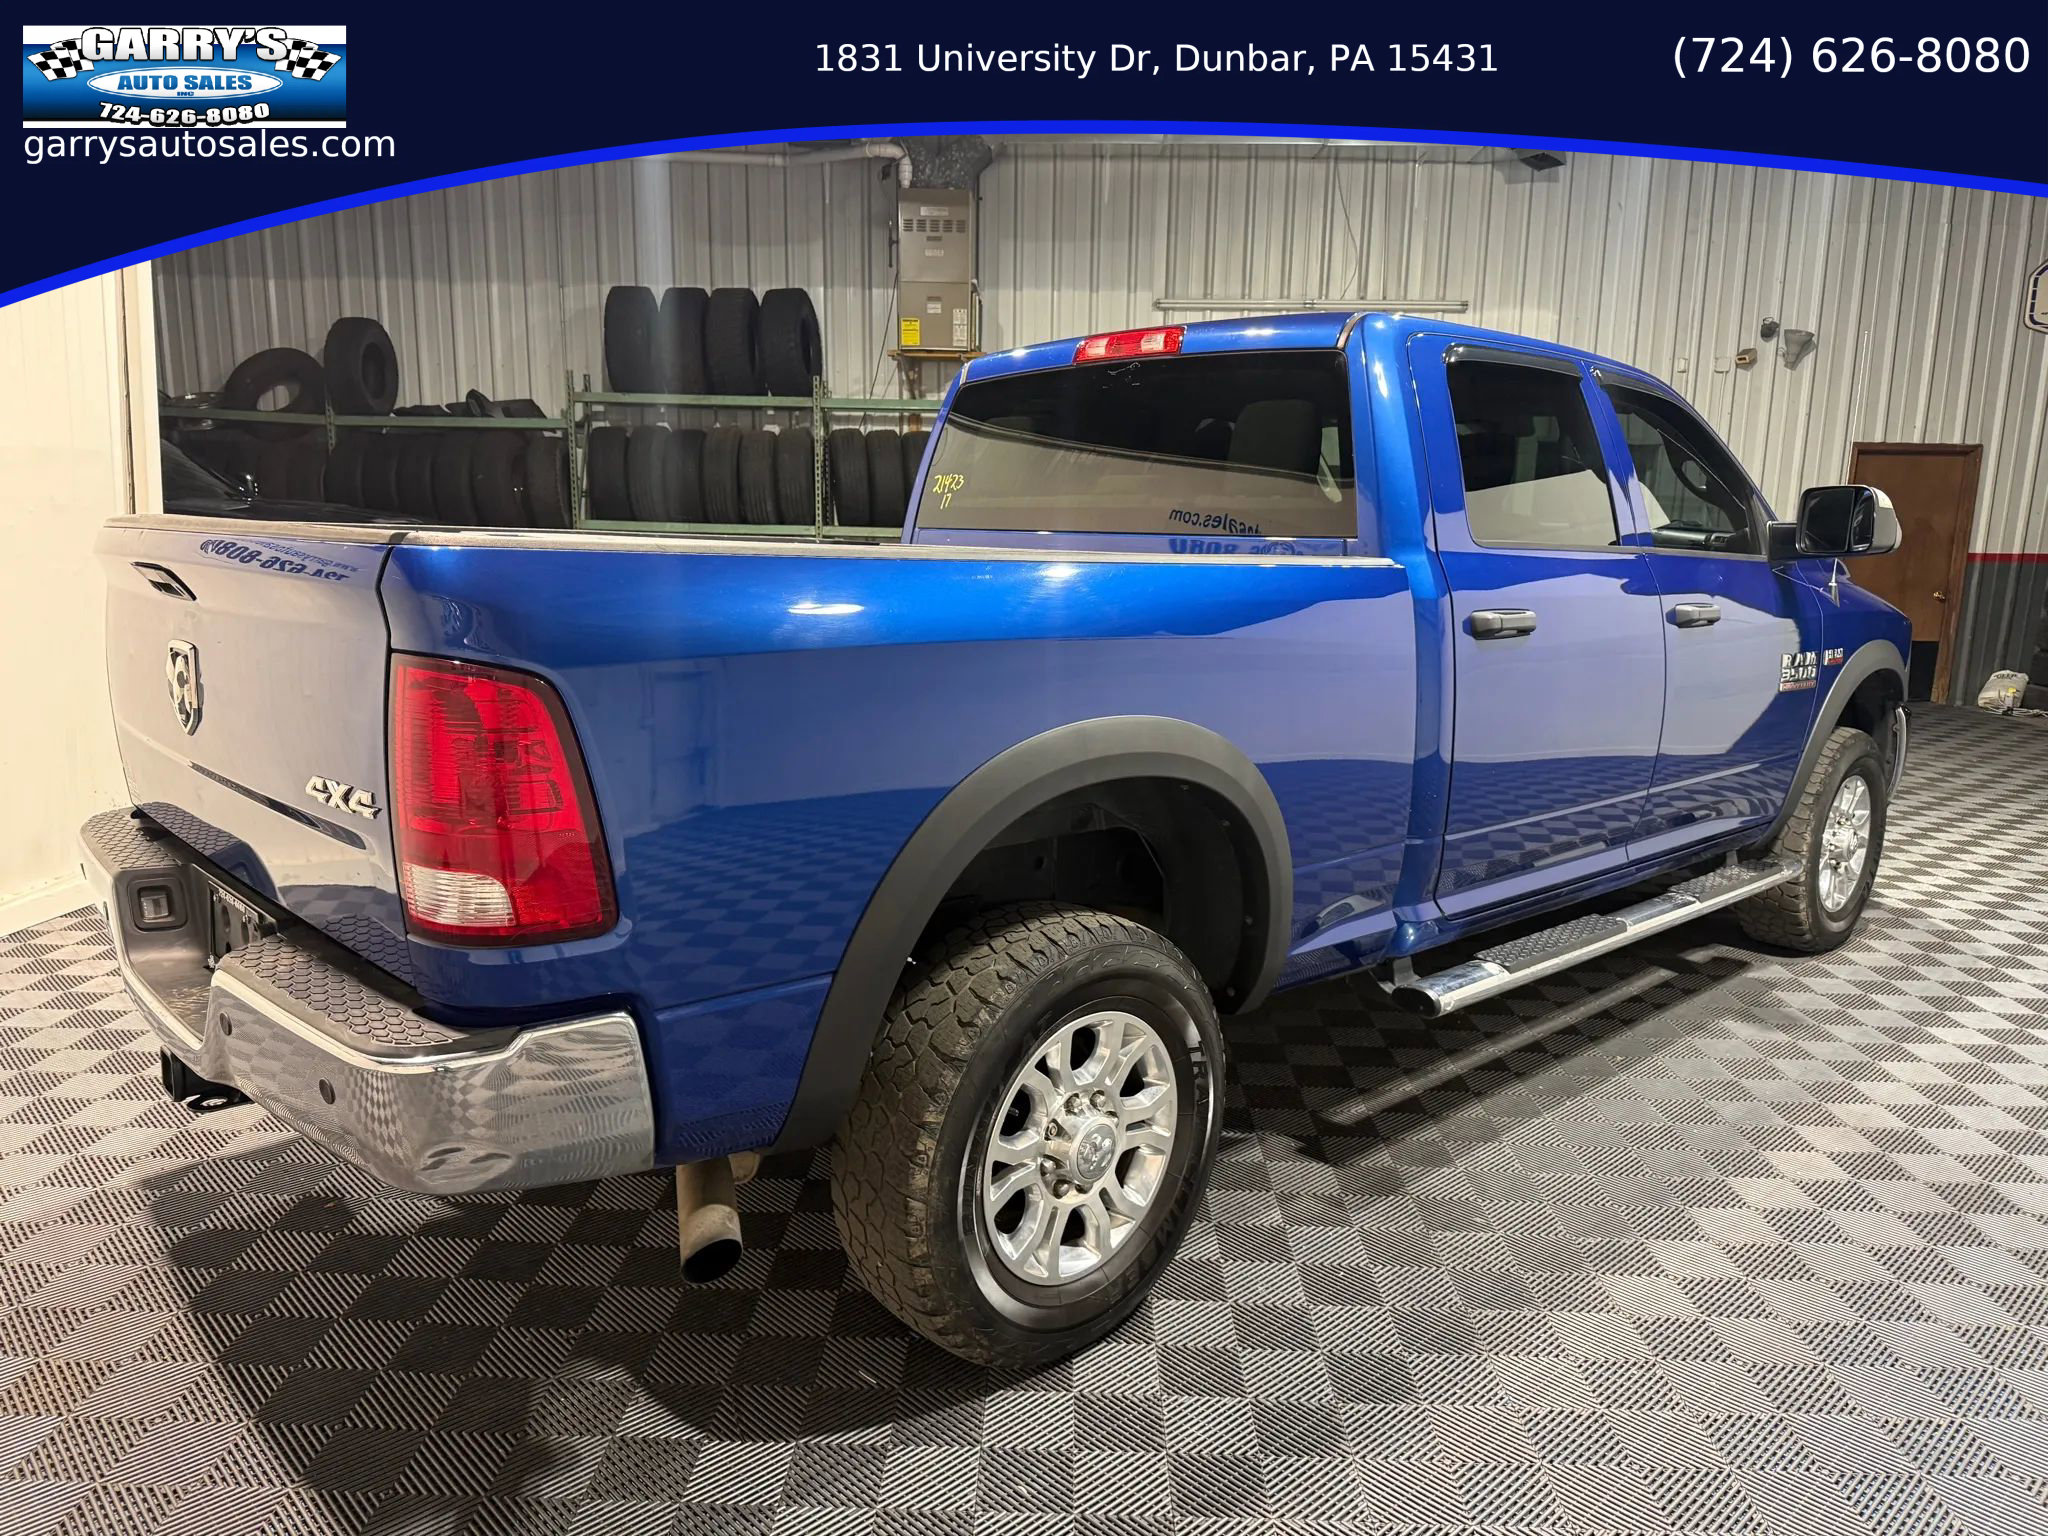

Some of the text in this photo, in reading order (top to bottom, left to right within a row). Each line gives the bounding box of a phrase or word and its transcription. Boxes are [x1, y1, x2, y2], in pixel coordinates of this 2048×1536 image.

[932, 474, 965, 494] 21423
[940, 493, 952, 510] 17
[1781, 651, 1817, 669] RAM
